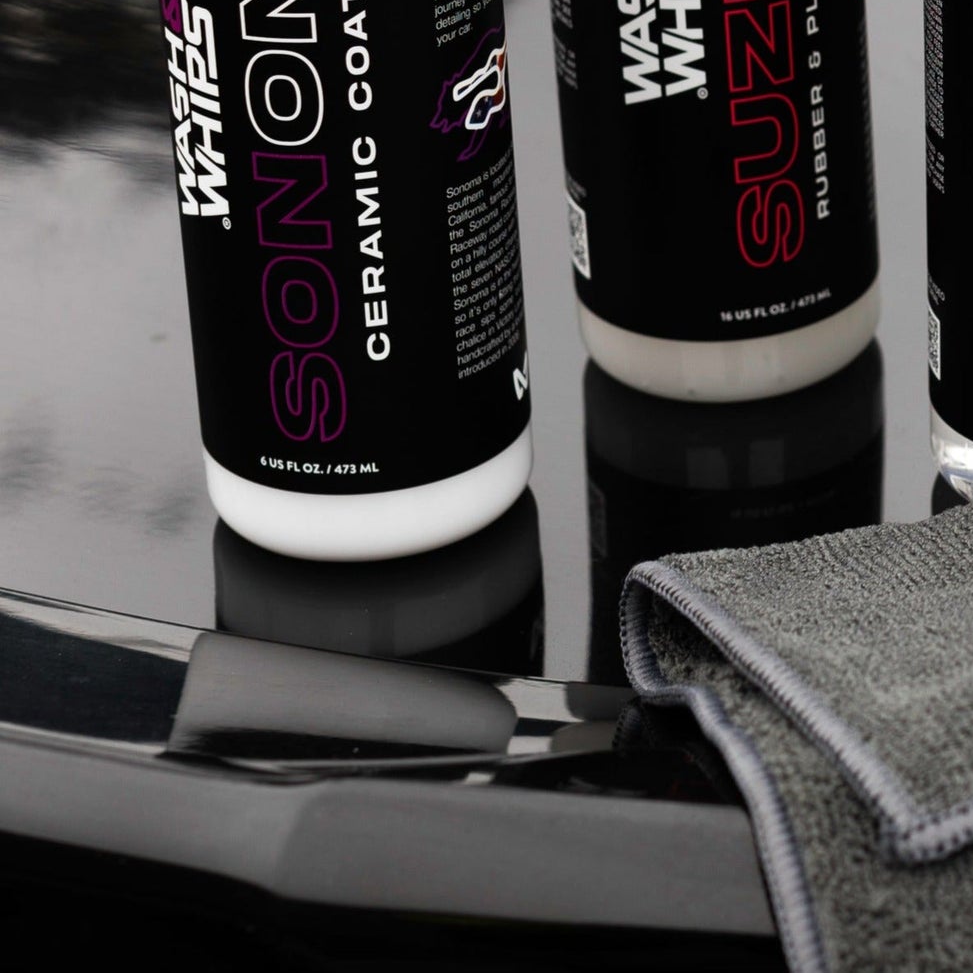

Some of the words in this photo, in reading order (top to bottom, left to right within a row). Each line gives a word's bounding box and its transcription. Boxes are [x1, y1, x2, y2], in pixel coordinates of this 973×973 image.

[436, 30, 457, 47] your
[809, 51, 822, 69] &
[811, 85, 830, 220] RUBBER
[446, 175, 482, 199] Sonoma
[447, 189, 485, 213] southern
[449, 228, 465, 241] the
[469, 207, 499, 232] Sonoma
[352, 136, 390, 362] CERAMIC
[450, 231, 488, 255] Raceway
[451, 257, 464, 269] on
[465, 254, 472, 263] a
[451, 265, 472, 283] total
[453, 284, 468, 297] the
[453, 287, 490, 311] Sonoma
[454, 313, 467, 325] so
[735, 308, 752, 320] US
[753, 307, 768, 318] FL
[455, 323, 476, 339] race
[456, 331, 487, 352] chalice
[458, 349, 501, 380] introduced
[269, 457, 284, 470] US
[286, 460, 301, 473] FL
[302, 463, 324, 474] OZ.
[334, 464, 357, 475] 473
[360, 462, 380, 474] ML
